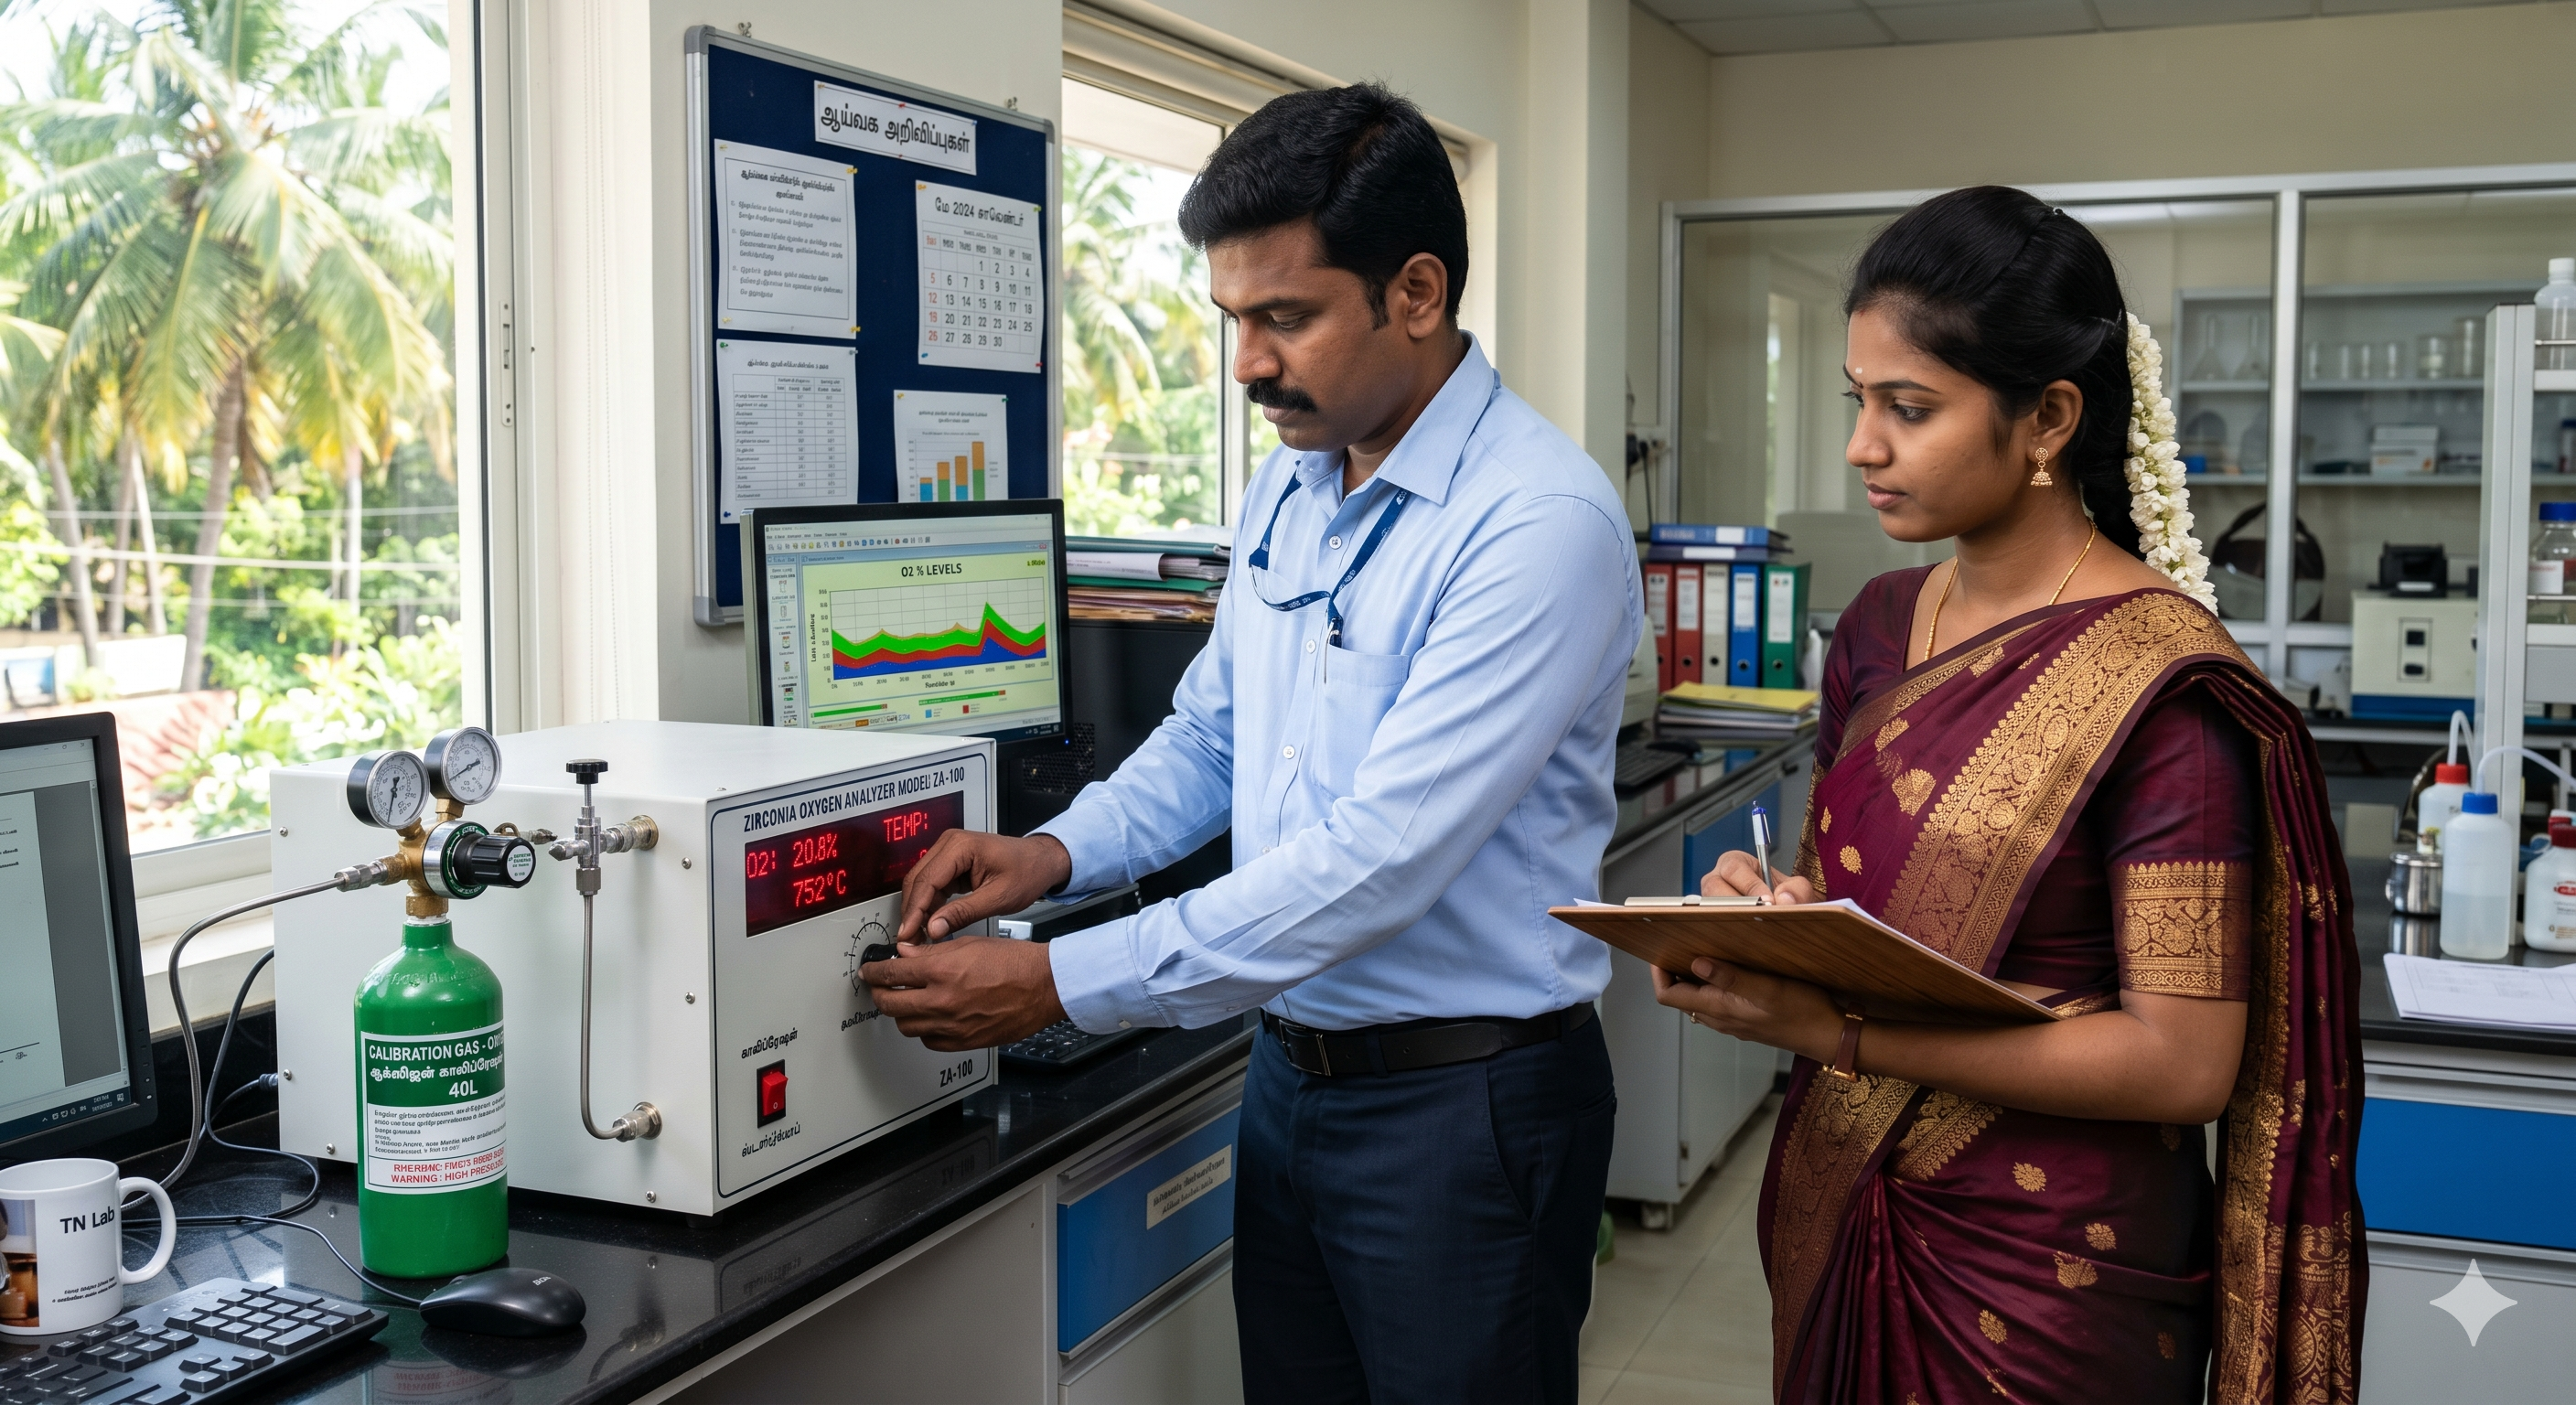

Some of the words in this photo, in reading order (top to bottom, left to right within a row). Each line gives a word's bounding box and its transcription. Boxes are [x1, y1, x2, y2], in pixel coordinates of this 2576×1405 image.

[821, 102, 879, 133] ஆய்வக
[885, 117, 970, 154] அறிவிப்புகள்
[953, 201, 974, 218] 2024
[980, 261, 983, 271] 1
[995, 263, 999, 273] 2
[1010, 265, 1014, 275] 3
[1025, 268, 1029, 277] 4
[930, 273, 935, 284] 5
[948, 274, 951, 285] 6
[963, 277, 968, 287] 7
[1009, 284, 1016, 294] 10
[1025, 286, 1031, 295] 11
[928, 293, 937, 303] 12
[946, 295, 954, 306] 13
[962, 296, 971, 306] 14
[979, 298, 986, 308] 15
[1009, 302, 1016, 312] 17
[946, 314, 954, 324] 20
[962, 316, 971, 326] 21
[979, 317, 986, 327] 22
[993, 318, 1002, 328] 23
[1008, 320, 1017, 330] 24
[1024, 322, 1032, 332] 25
[946, 332, 954, 342] 27
[993, 337, 1002, 347] 30
[917, 565, 924, 576] %
[927, 563, 962, 575] LEVELS
[744, 805, 797, 832] ZIRCONIA
[800, 794, 842, 820] OXYGEN
[844, 782, 895, 809] ANALYZER
[933, 767, 964, 788] ZA-100
[884, 811, 928, 842] TEMP:
[370, 1045, 452, 1061] CALIBRATION
[455, 1041, 479, 1057] GAS
[940, 1059, 973, 1088] ZA-100
[448, 1079, 478, 1098] 40L
[445, 1171, 468, 1182] HIGH
[59, 1215, 86, 1234] TN
[91, 1206, 115, 1228] Lab
